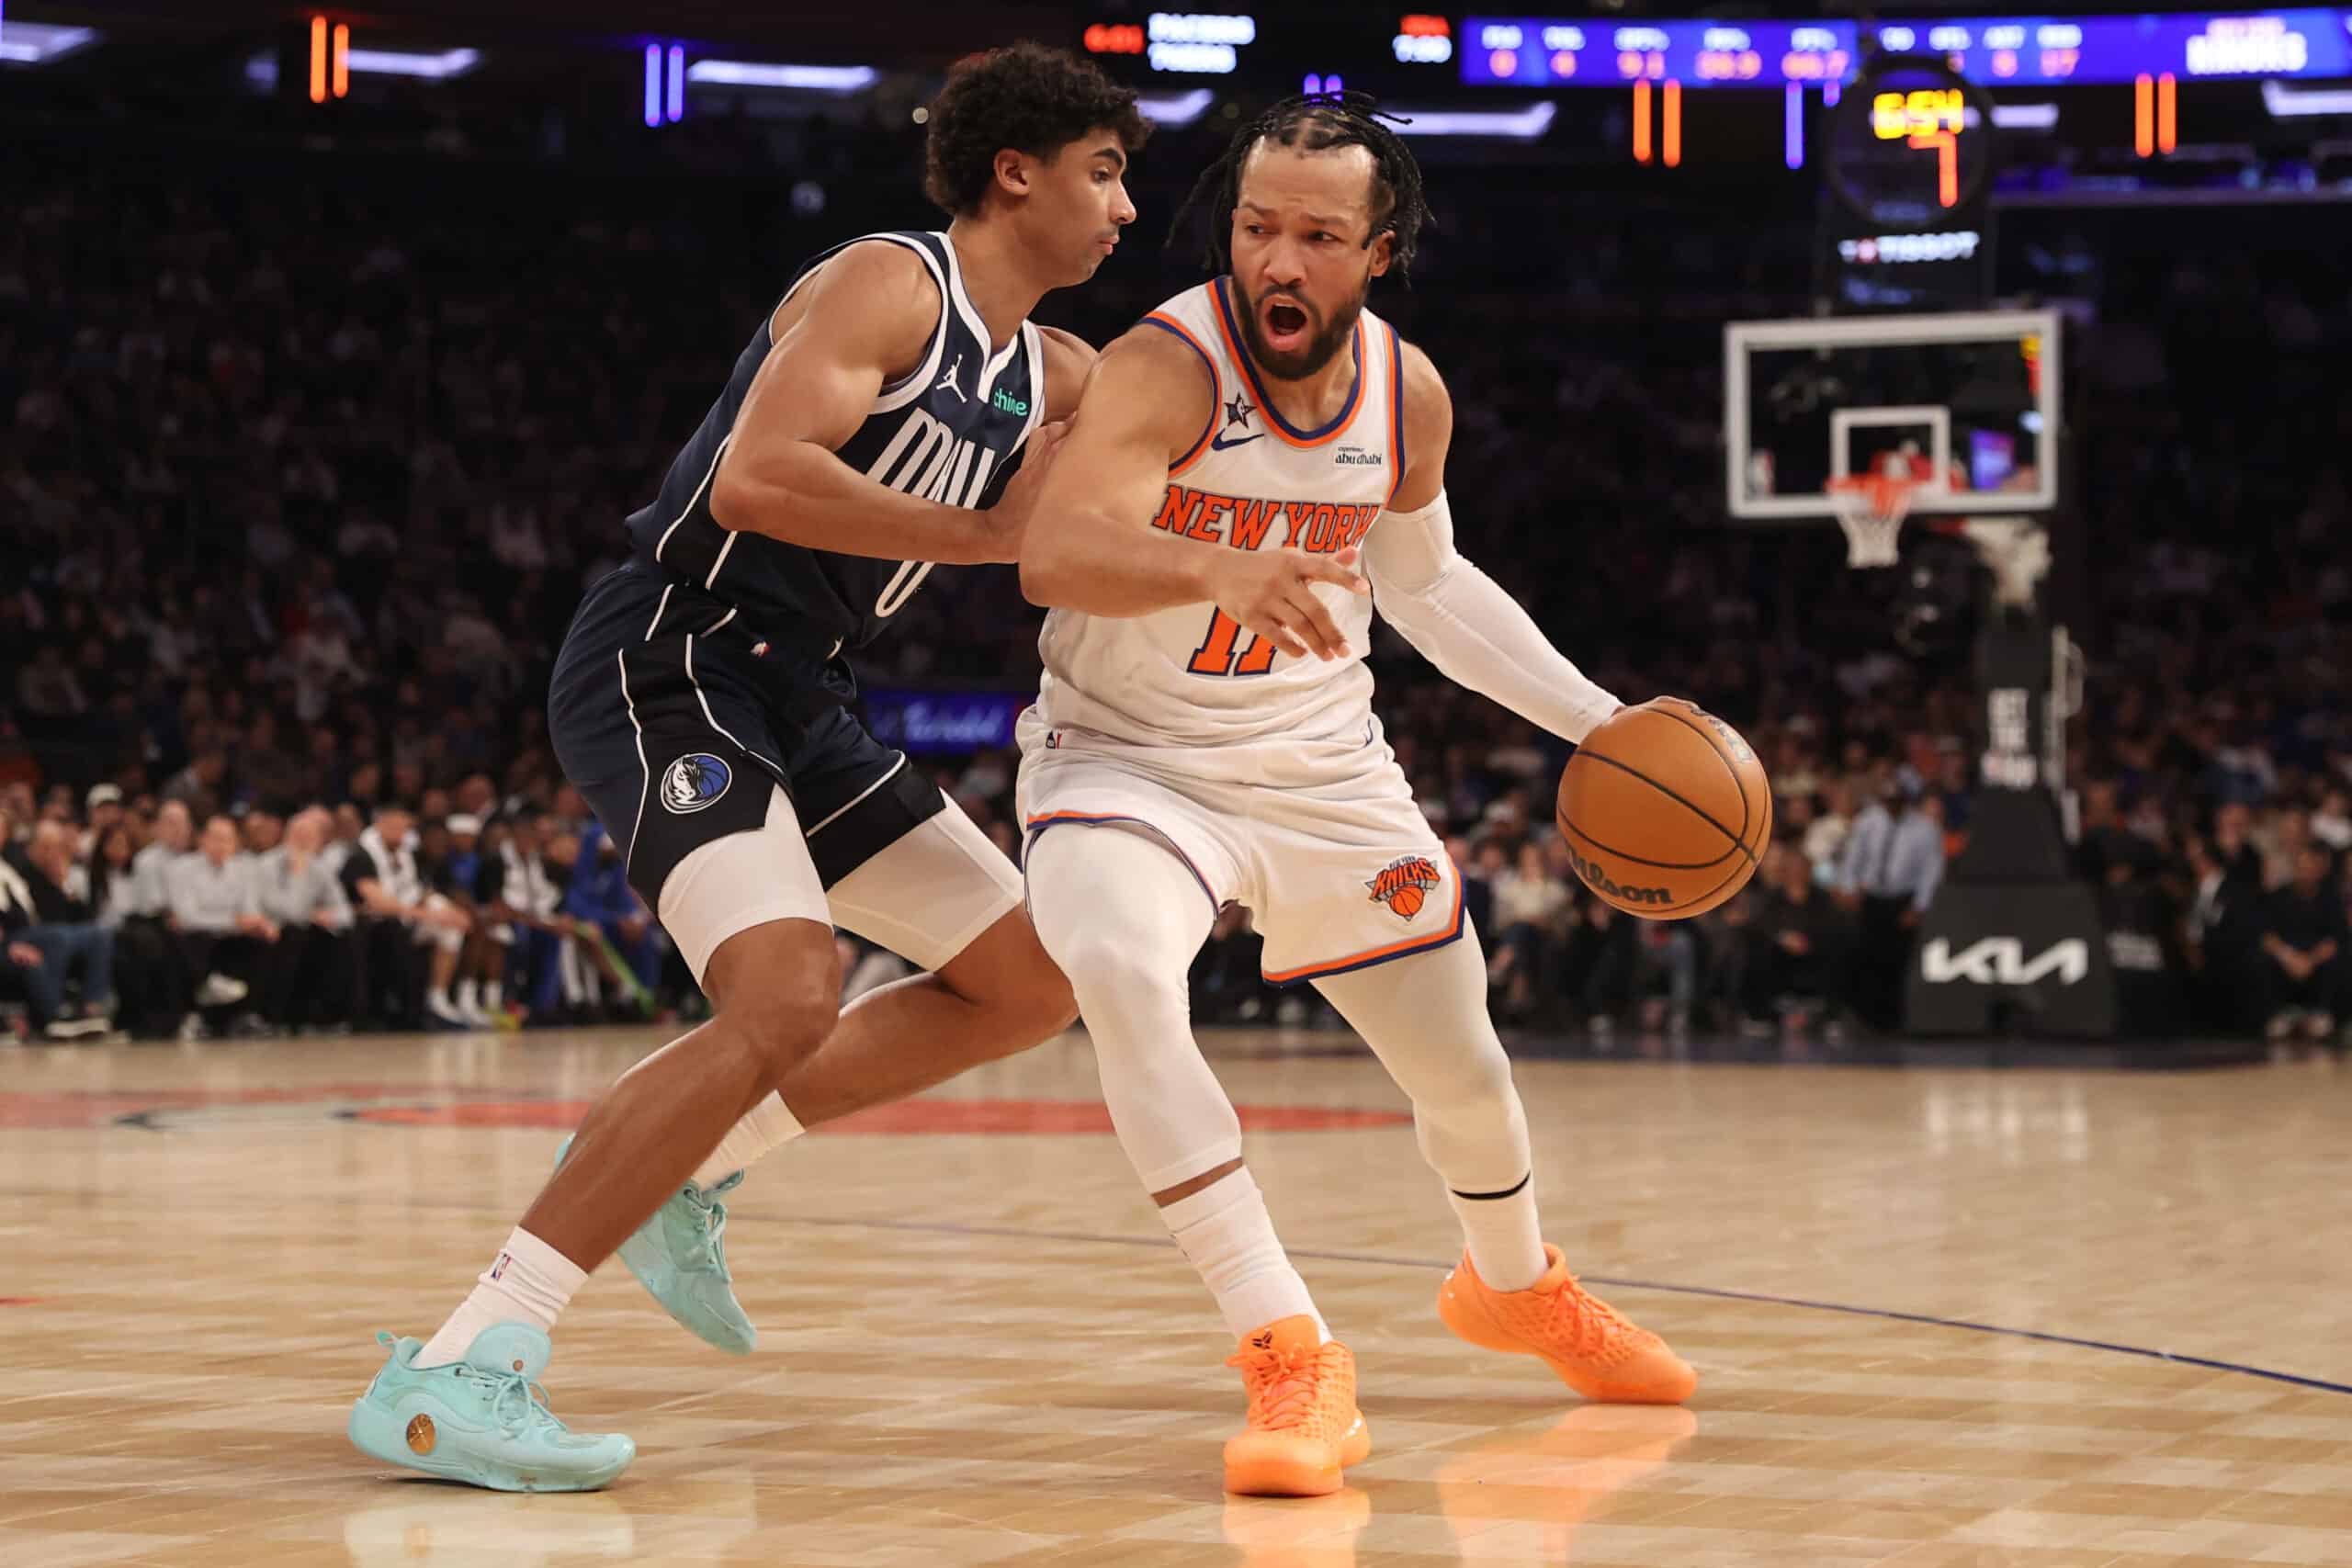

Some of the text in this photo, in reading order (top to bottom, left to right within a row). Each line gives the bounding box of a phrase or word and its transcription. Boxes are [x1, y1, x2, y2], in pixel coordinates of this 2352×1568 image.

[1336, 453, 1355, 464] abu
[1151, 484, 1384, 553] NEW YORK
[1370, 857, 1442, 900] KNICKS
